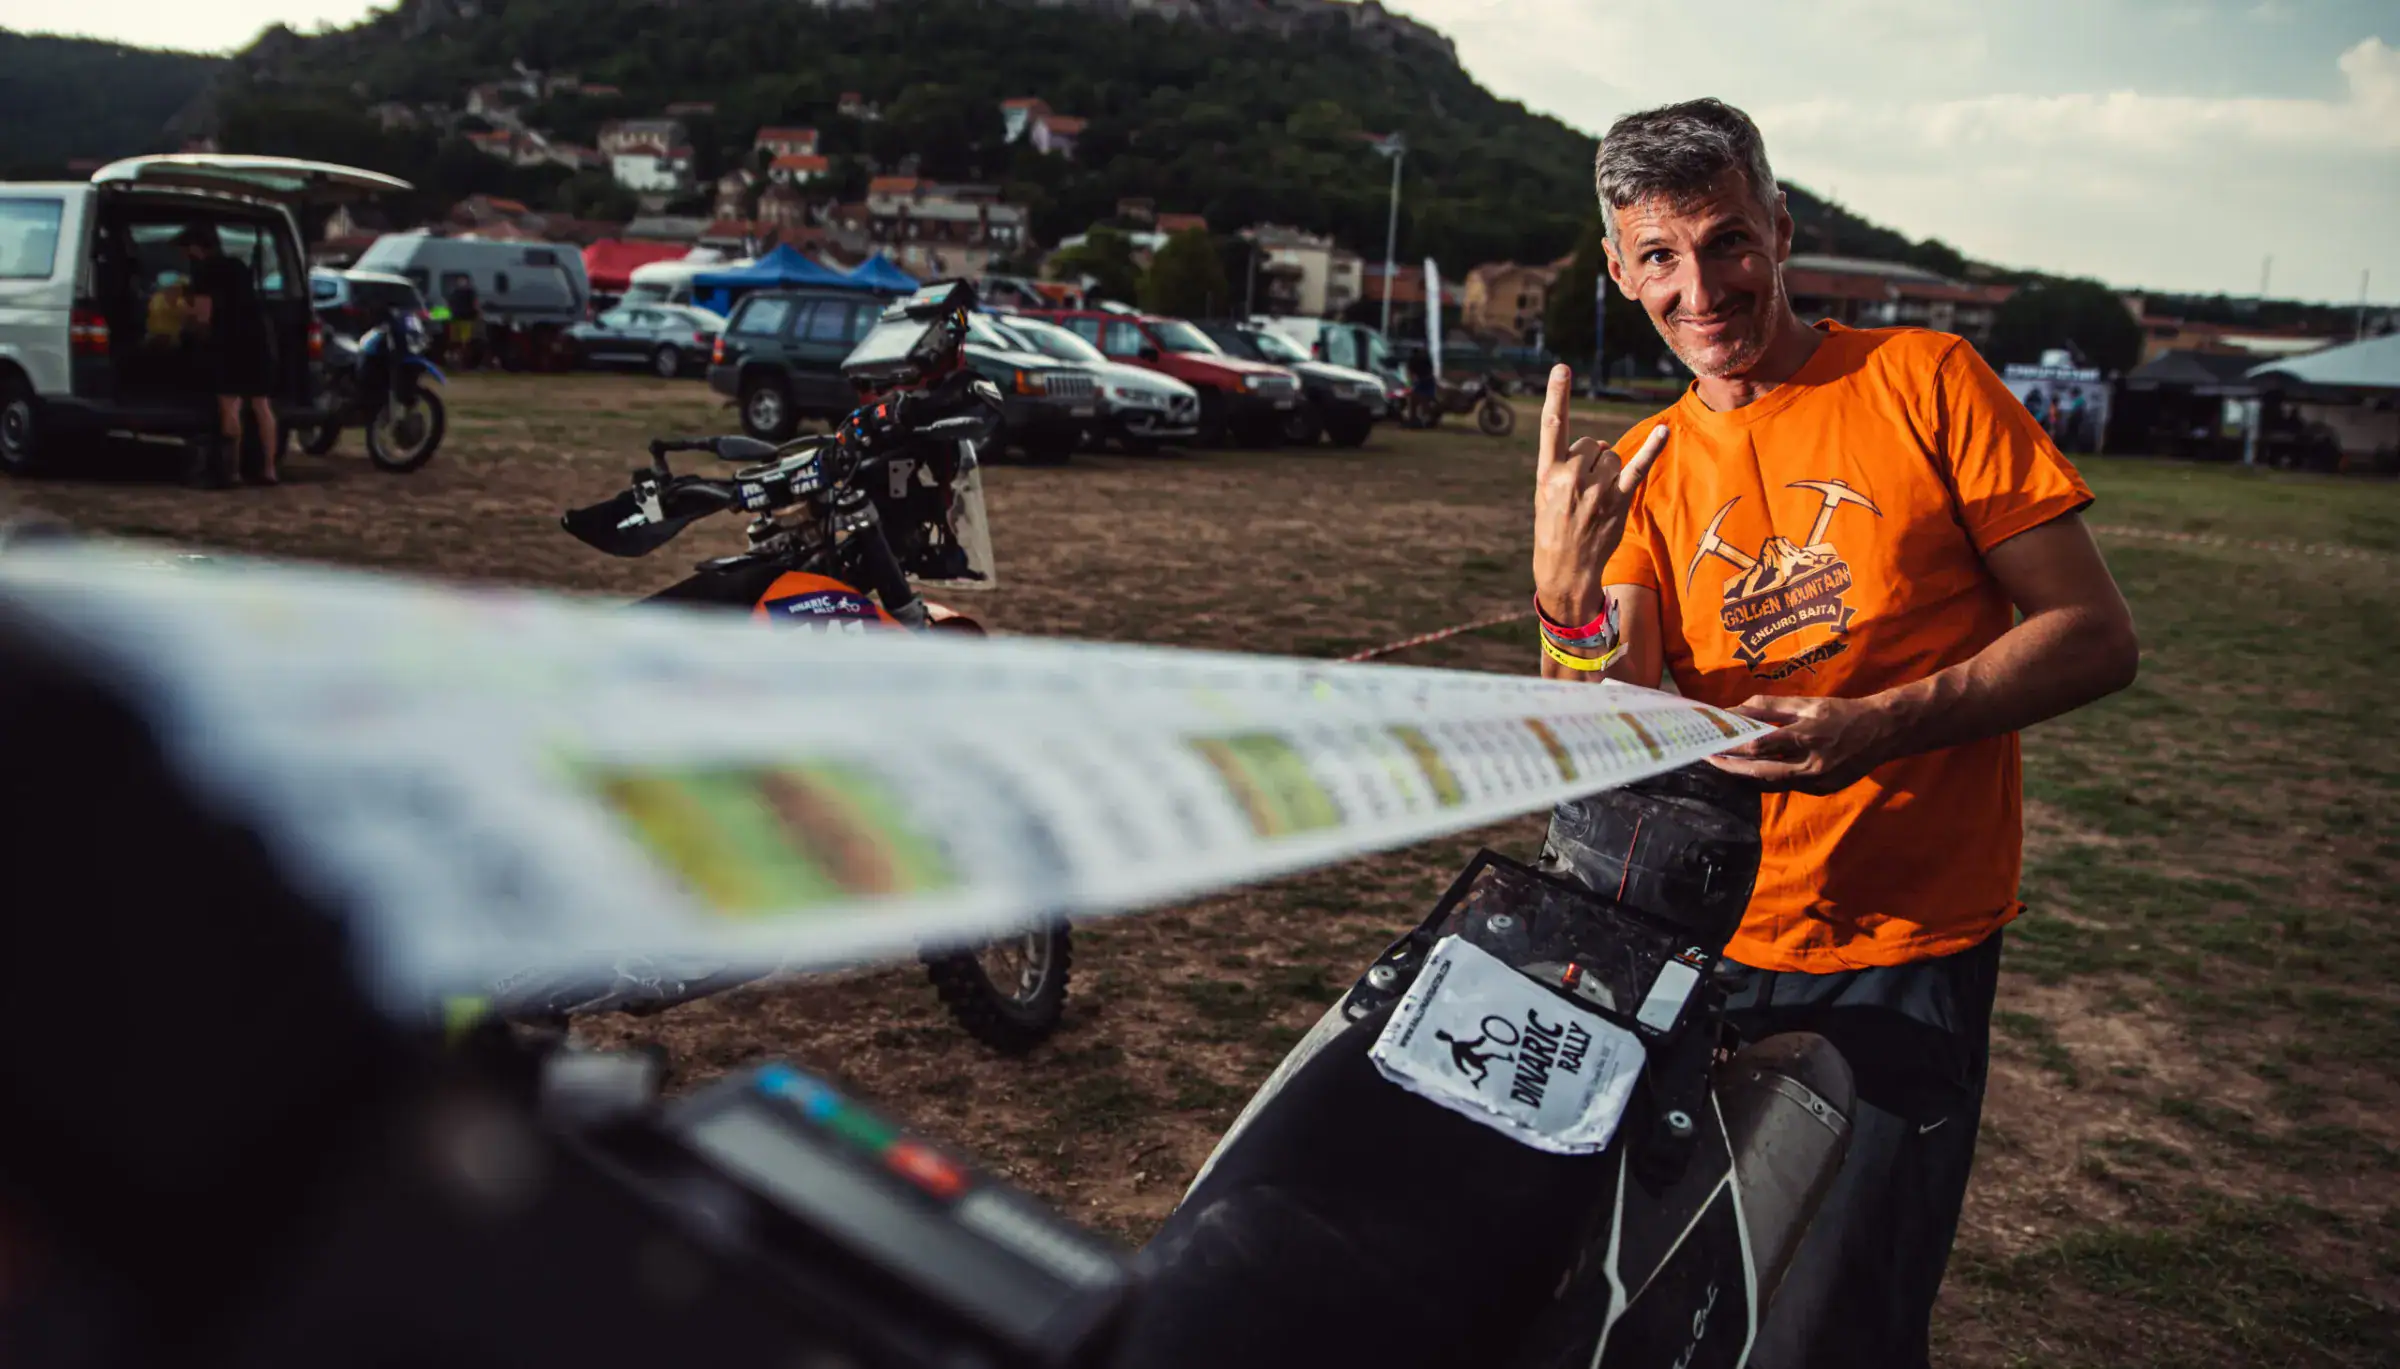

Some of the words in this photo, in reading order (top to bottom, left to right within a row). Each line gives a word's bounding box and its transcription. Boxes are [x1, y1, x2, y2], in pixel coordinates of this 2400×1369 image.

[1724, 596, 1781, 627] GOLDEN
[1784, 566, 1849, 608] MOUNTAIN
[1750, 615, 1797, 646] ENDURO
[1799, 604, 1836, 620] BAITA
[1510, 1008, 1563, 1109] DINARIC
[1557, 1021, 1592, 1075] RALLY
